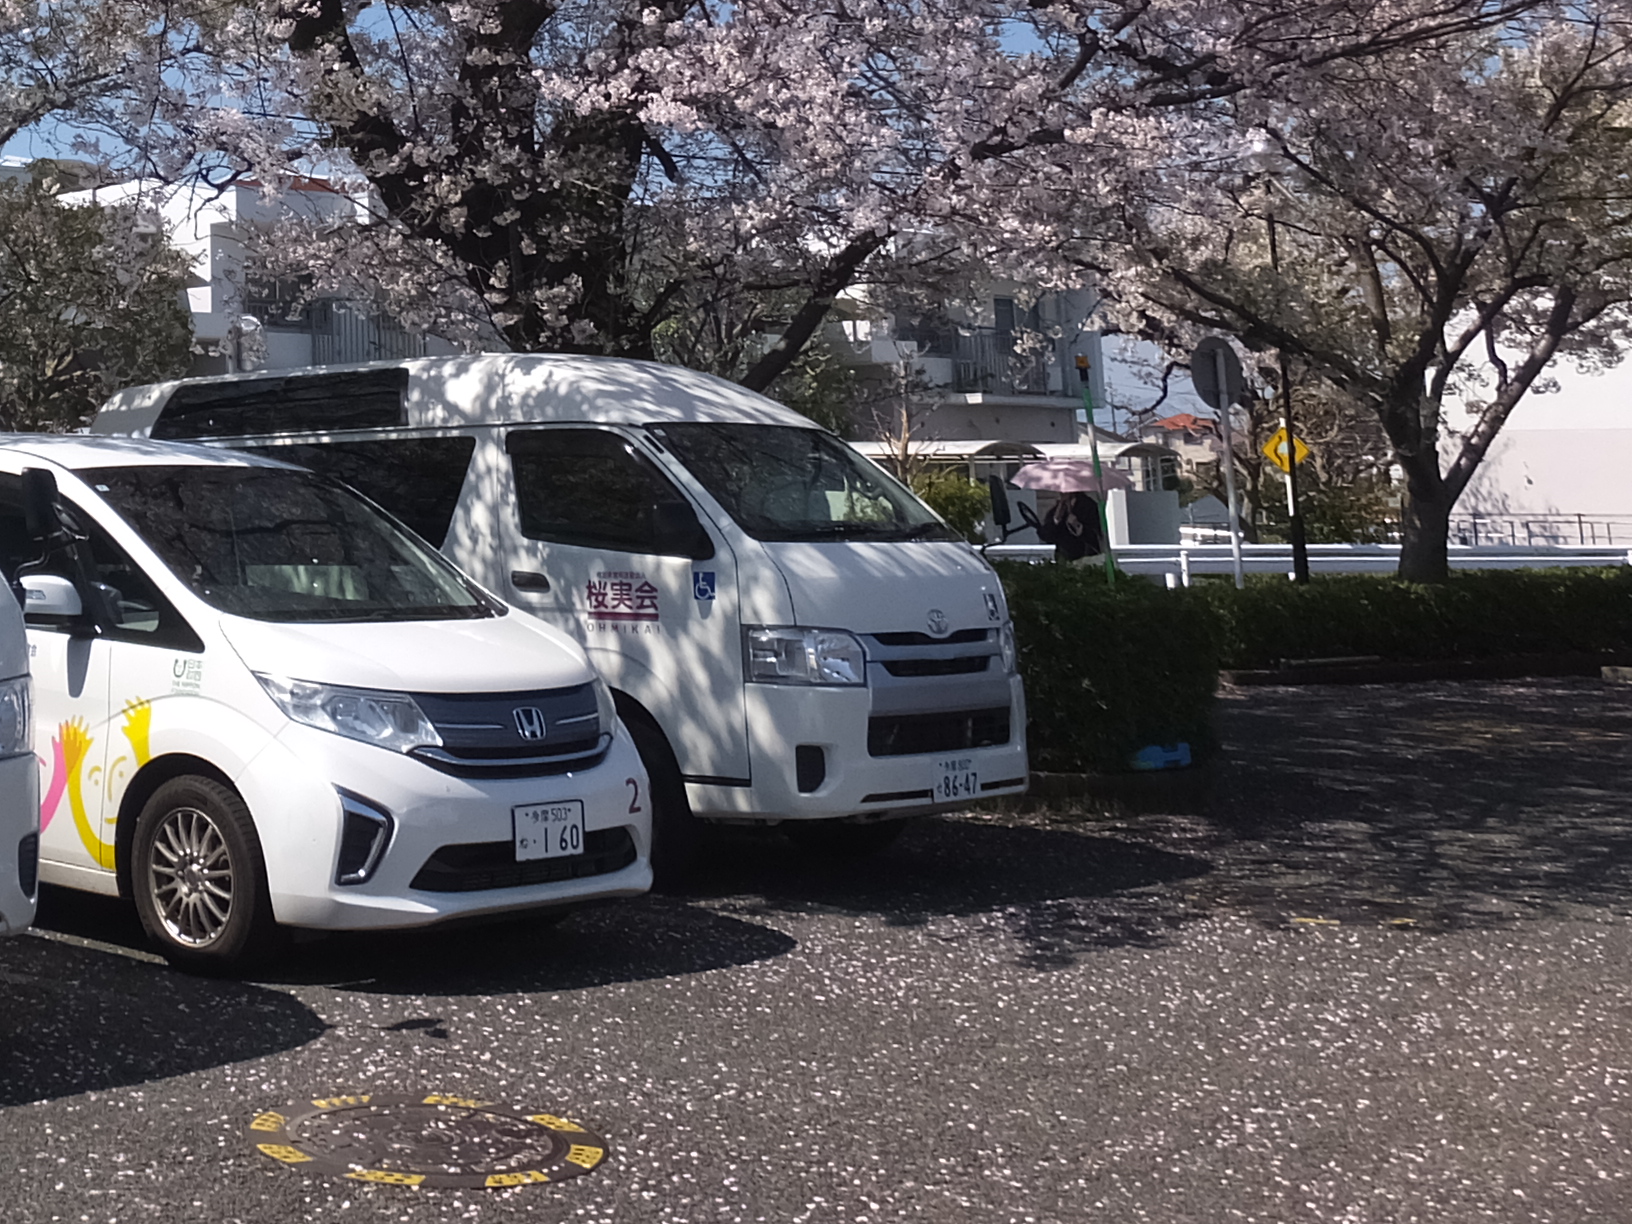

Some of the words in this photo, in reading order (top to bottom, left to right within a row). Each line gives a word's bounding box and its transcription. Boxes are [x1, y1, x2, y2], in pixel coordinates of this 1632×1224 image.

[586, 579, 659, 611] 桜実会
[587, 622, 661, 634] OHMIKAI
[625, 777, 642, 814] 2
